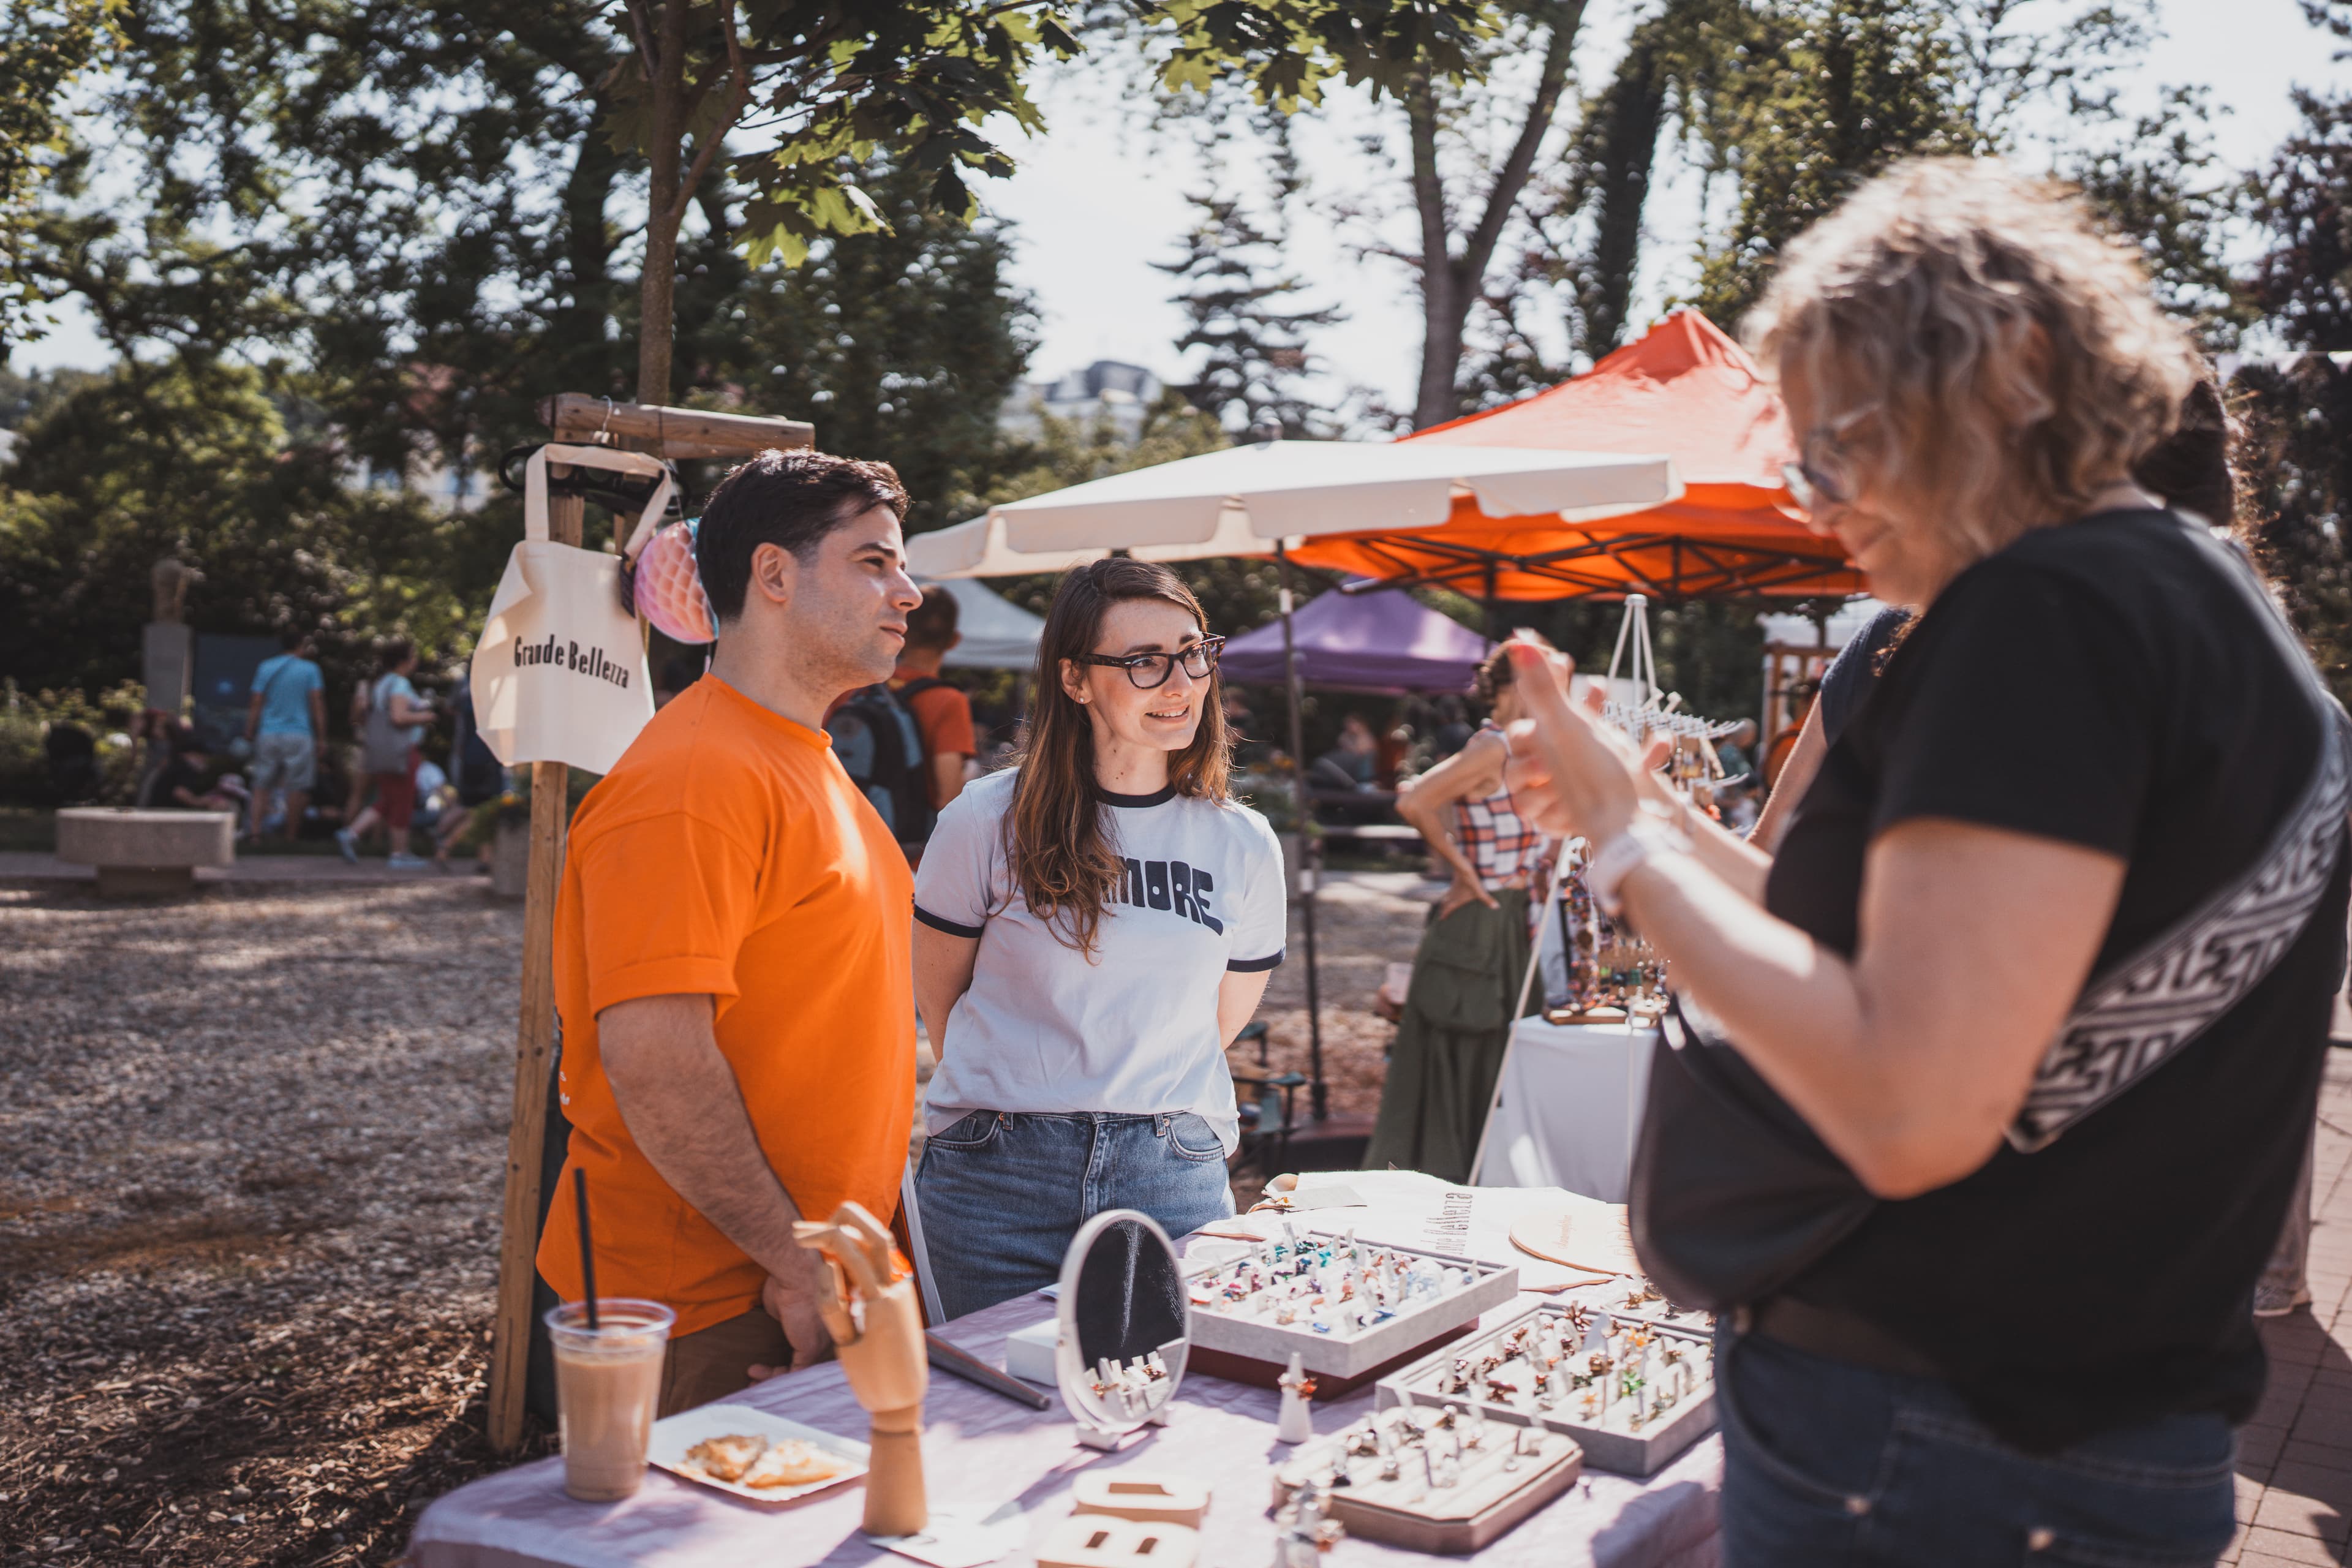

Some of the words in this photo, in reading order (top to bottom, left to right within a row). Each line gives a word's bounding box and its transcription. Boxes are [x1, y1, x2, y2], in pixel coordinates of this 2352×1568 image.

[514, 633, 565, 668] Grande
[568, 640, 629, 689] Bellezza
[1101, 855, 1224, 937] MORE
